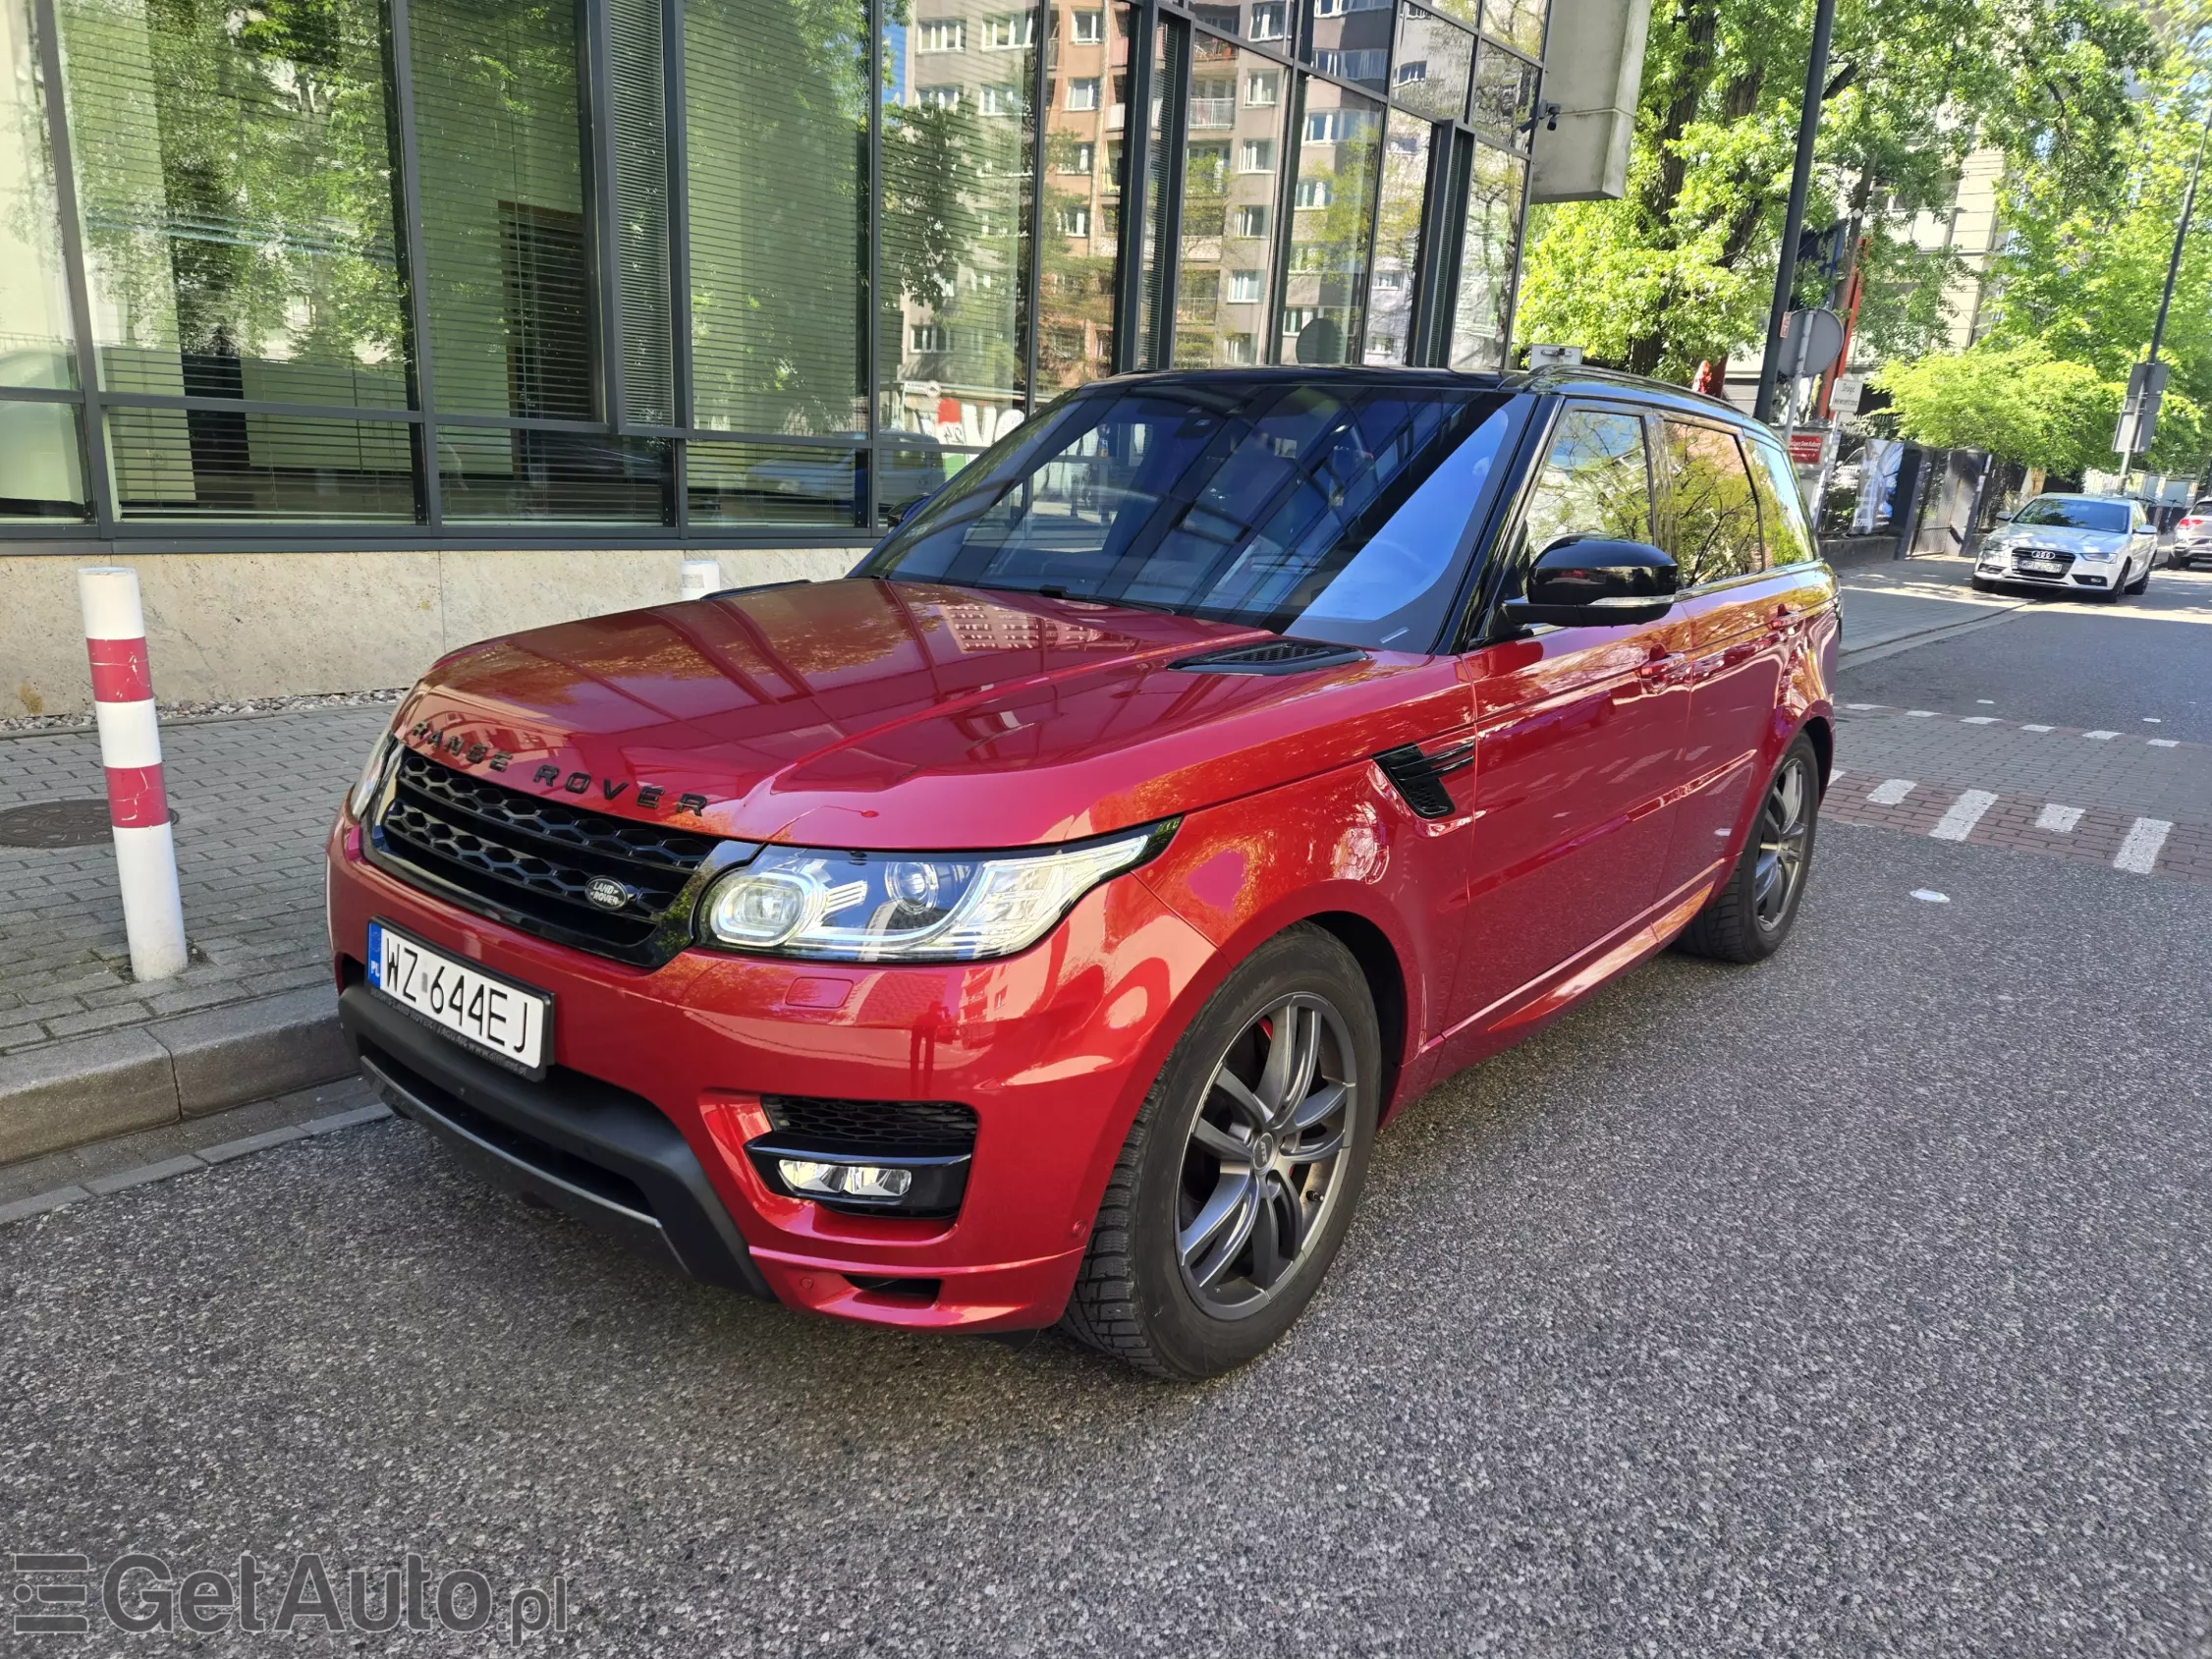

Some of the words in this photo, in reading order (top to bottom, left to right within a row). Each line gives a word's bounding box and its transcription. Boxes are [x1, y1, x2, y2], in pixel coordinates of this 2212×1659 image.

[412, 719, 513, 773] RANGE
[532, 764, 708, 817] ROVER
[592, 881, 615, 895] LAND
[592, 890, 620, 906] ROVER
[370, 960, 380, 977] PL
[386, 937, 418, 1003] WZ
[430, 965, 528, 1053] 644EJ
